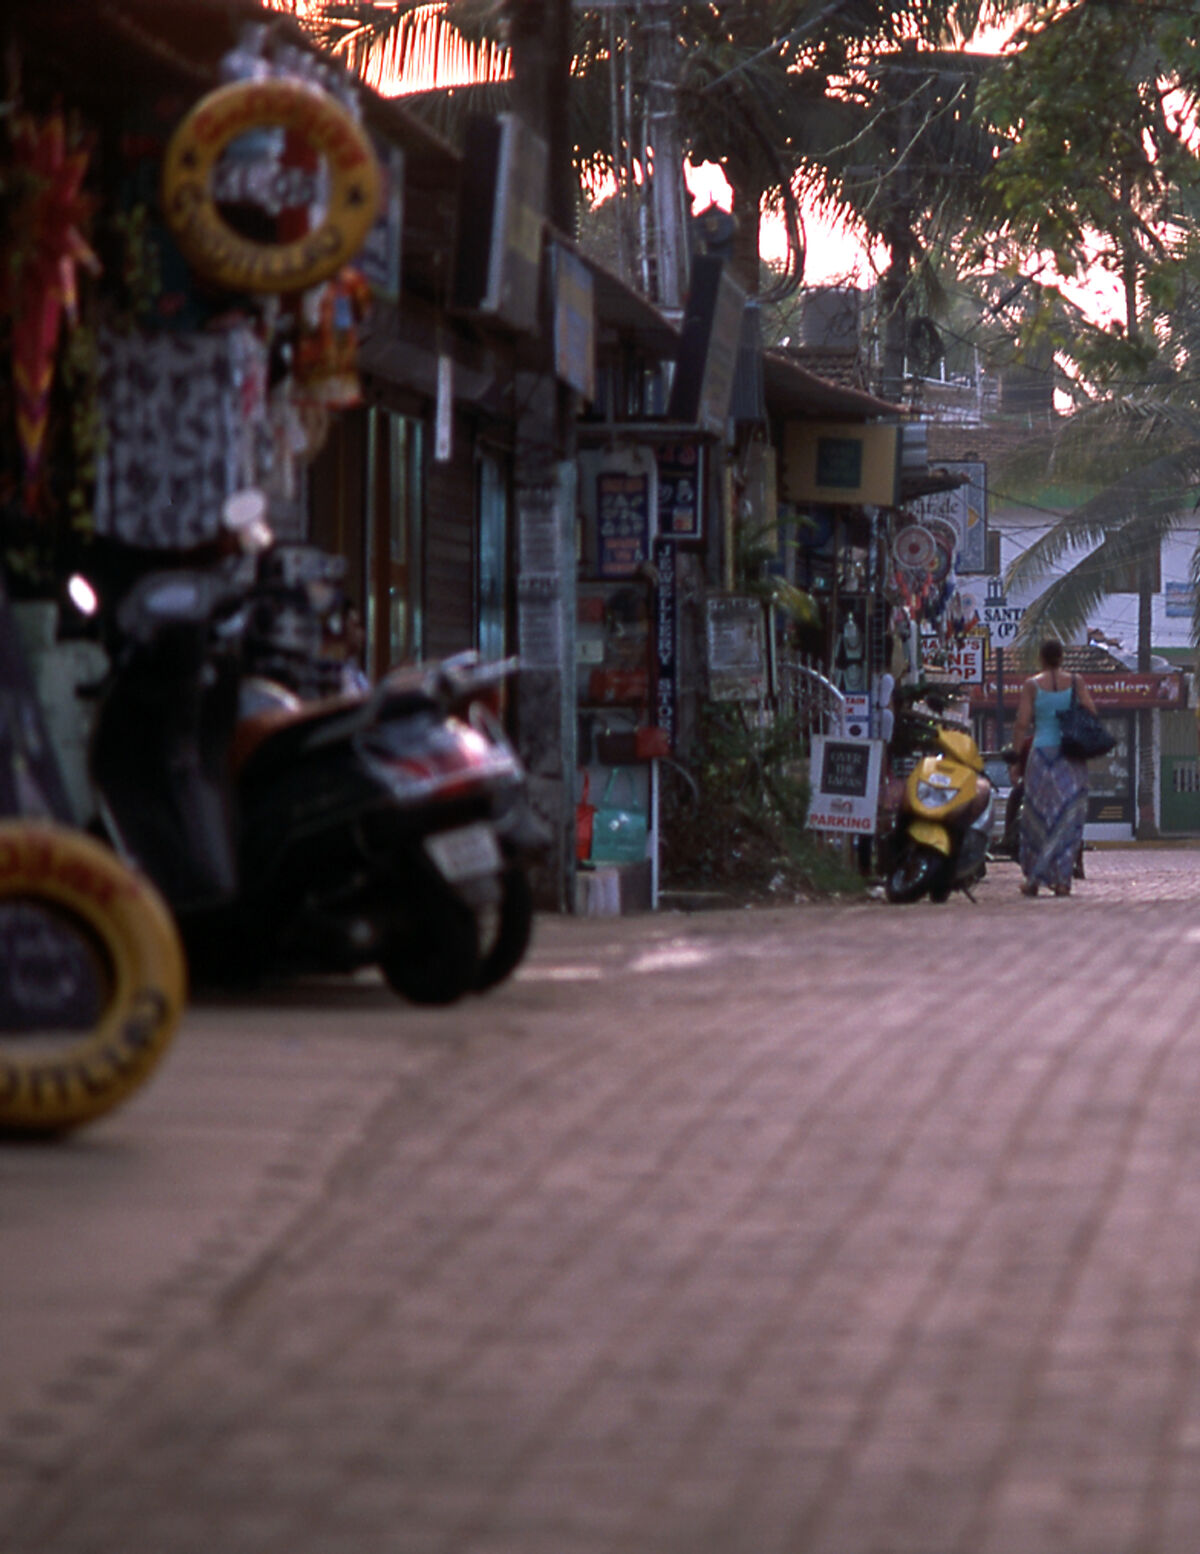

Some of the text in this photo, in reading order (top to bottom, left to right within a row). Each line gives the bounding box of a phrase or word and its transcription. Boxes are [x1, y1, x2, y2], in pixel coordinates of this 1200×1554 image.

[658, 545, 673, 665] JEWELLERY
[1084, 681, 1150, 697] ewellery
[809, 813, 871, 829] PARKING
